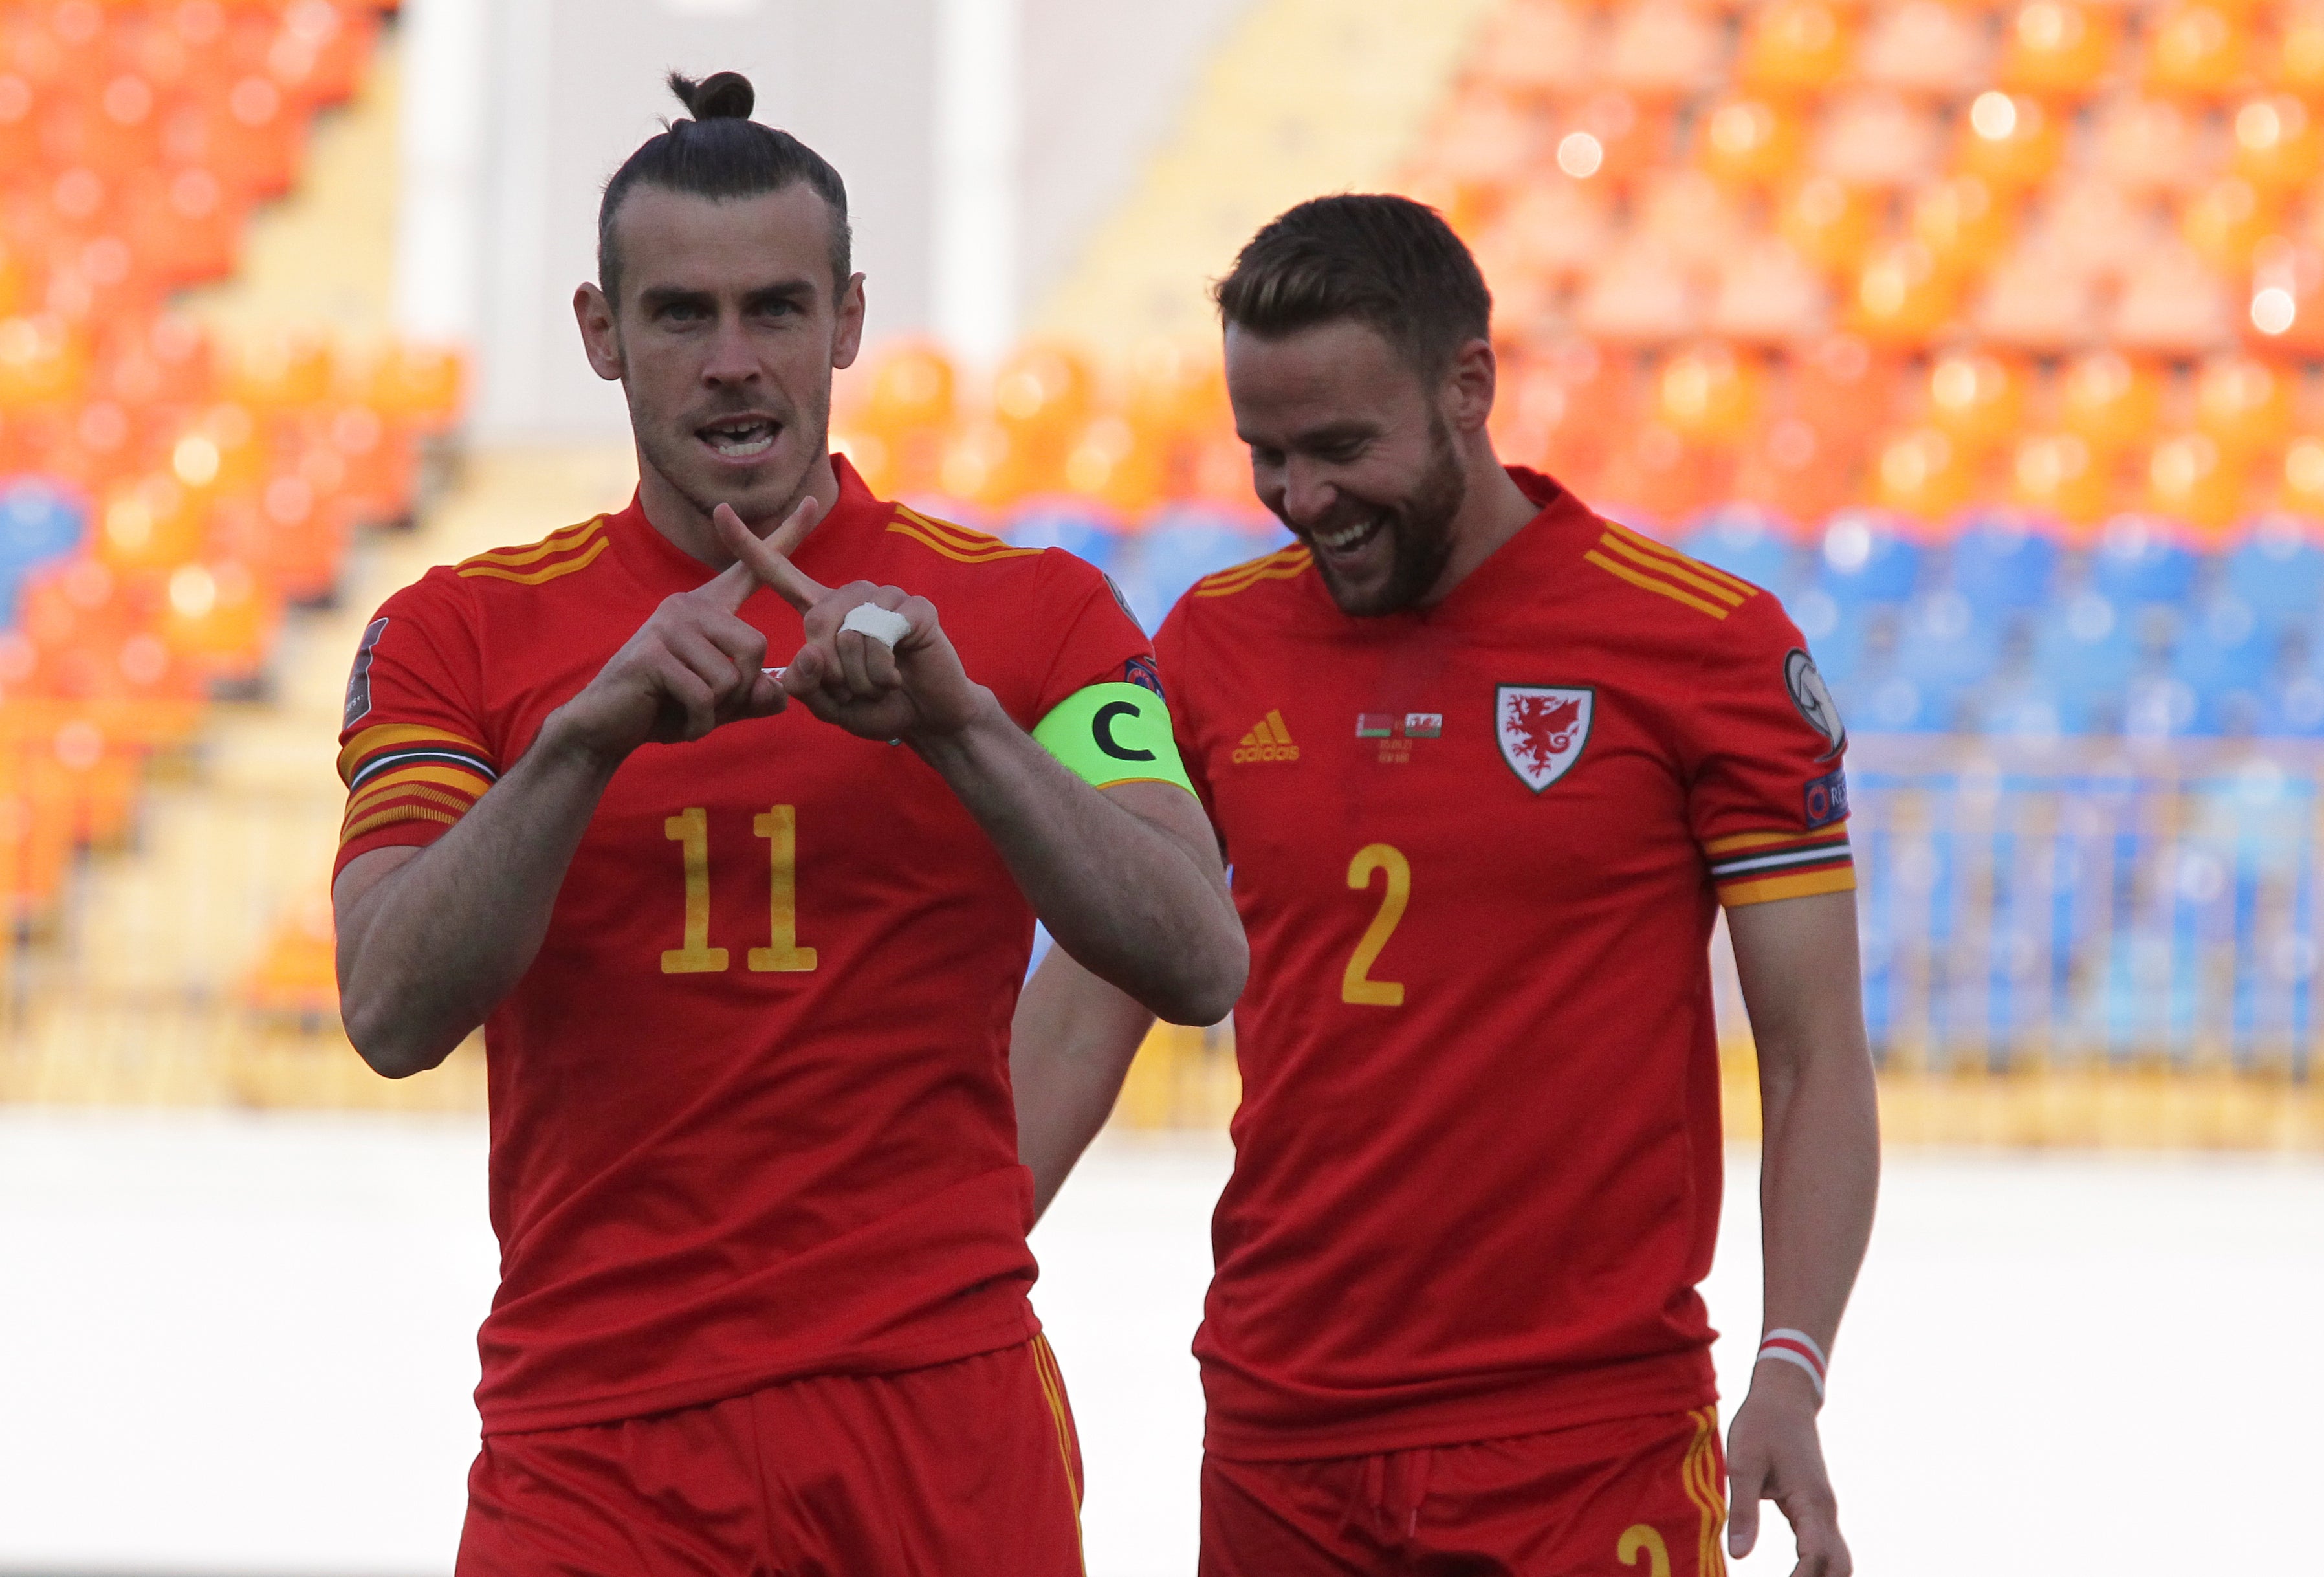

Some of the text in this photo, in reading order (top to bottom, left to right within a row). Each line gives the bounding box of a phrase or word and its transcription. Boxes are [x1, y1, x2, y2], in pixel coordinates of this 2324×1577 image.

[1093, 701, 1156, 761] C
[1232, 744, 1300, 764] adidas
[661, 804, 817, 974] 11
[1341, 843, 1411, 1007] 2
